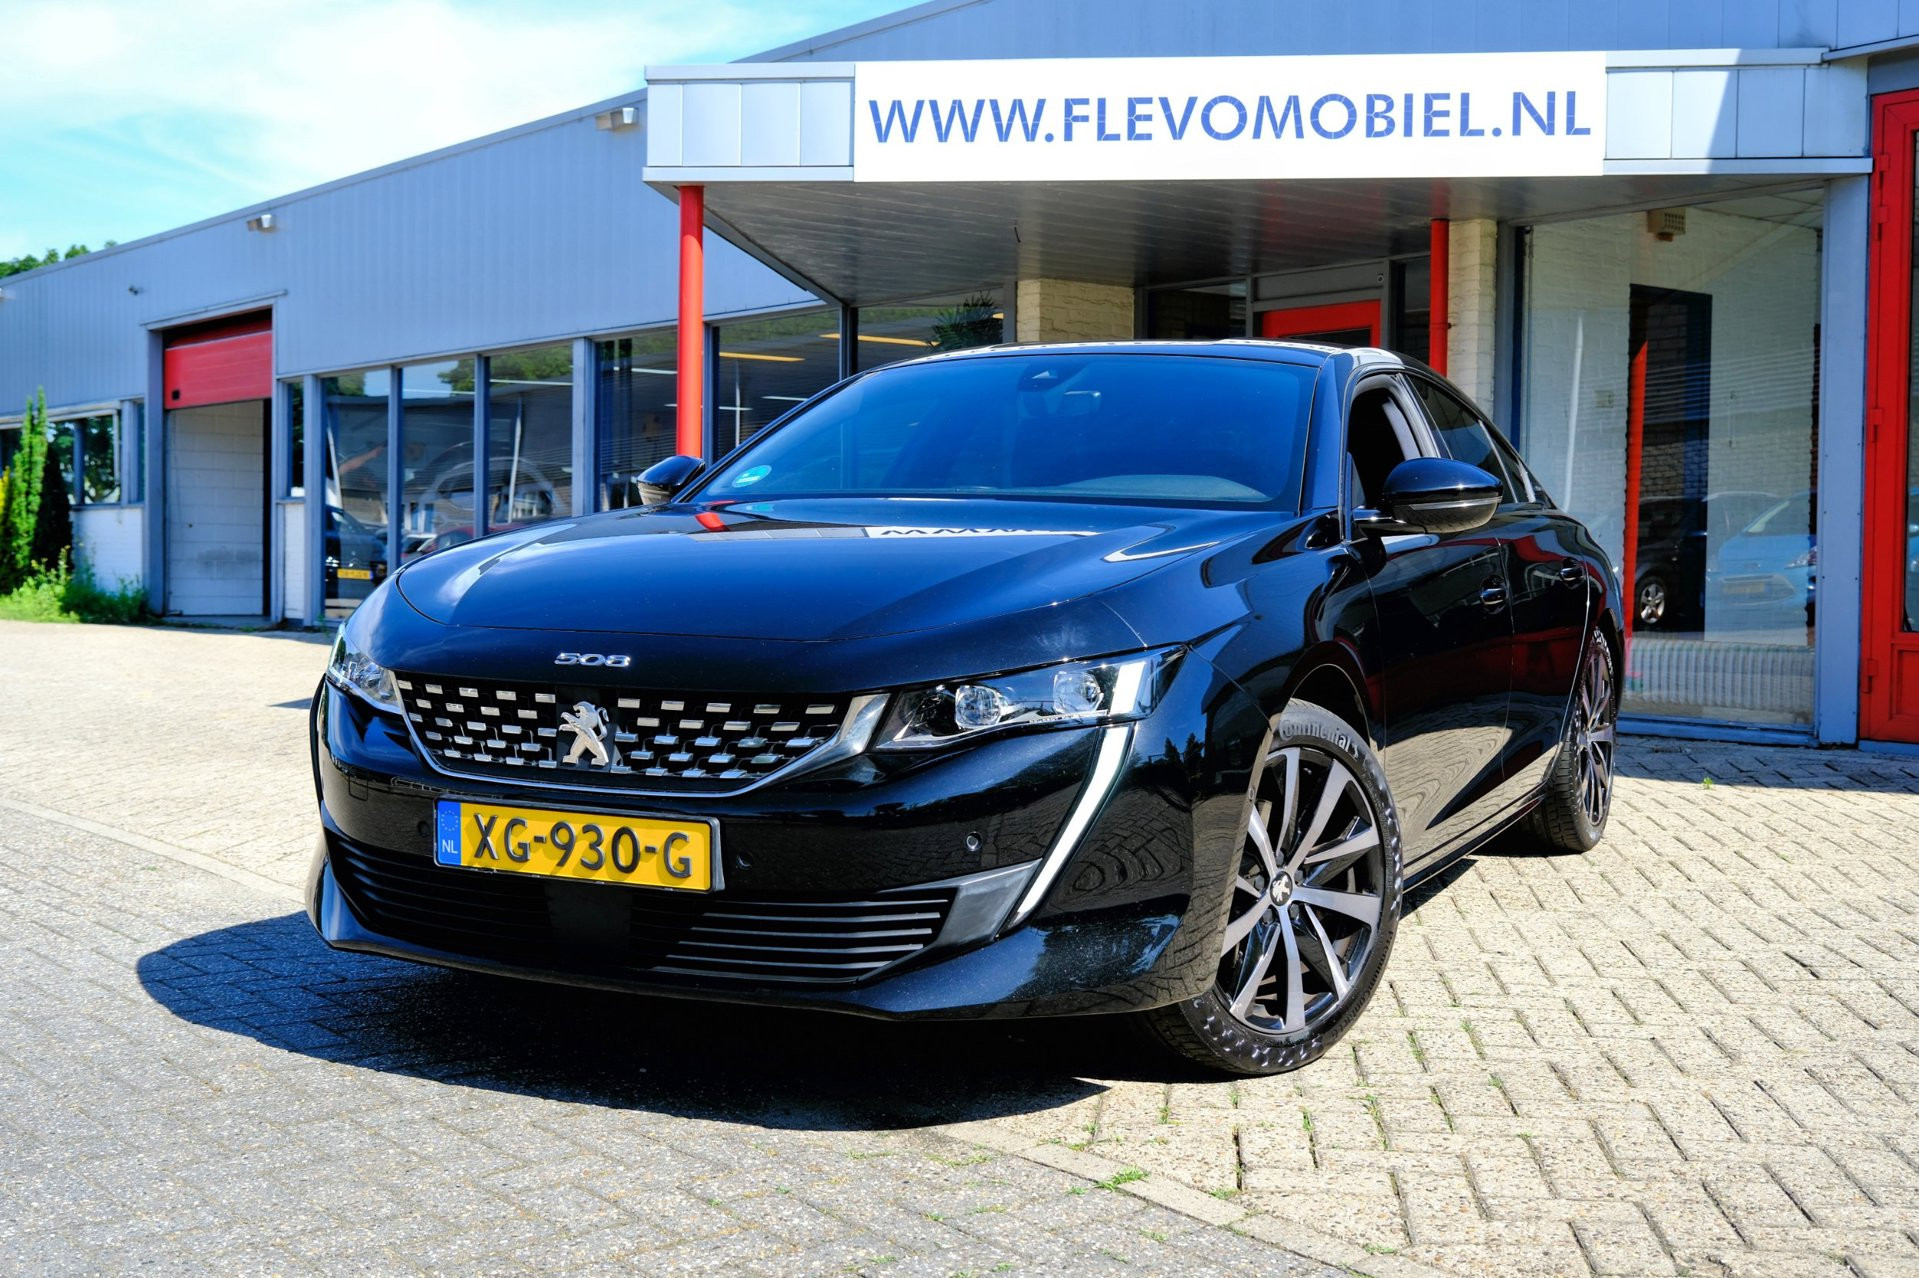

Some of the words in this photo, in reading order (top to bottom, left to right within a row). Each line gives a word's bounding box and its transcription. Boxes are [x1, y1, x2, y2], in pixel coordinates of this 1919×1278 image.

[868, 91, 1592, 143] WWW.FLEVOMOBIEL.NL
[554, 652, 631, 668] 508
[1279, 719, 1351, 753] Continental
[442, 838, 458, 854] NL
[473, 812, 692, 878] XG-930-G
